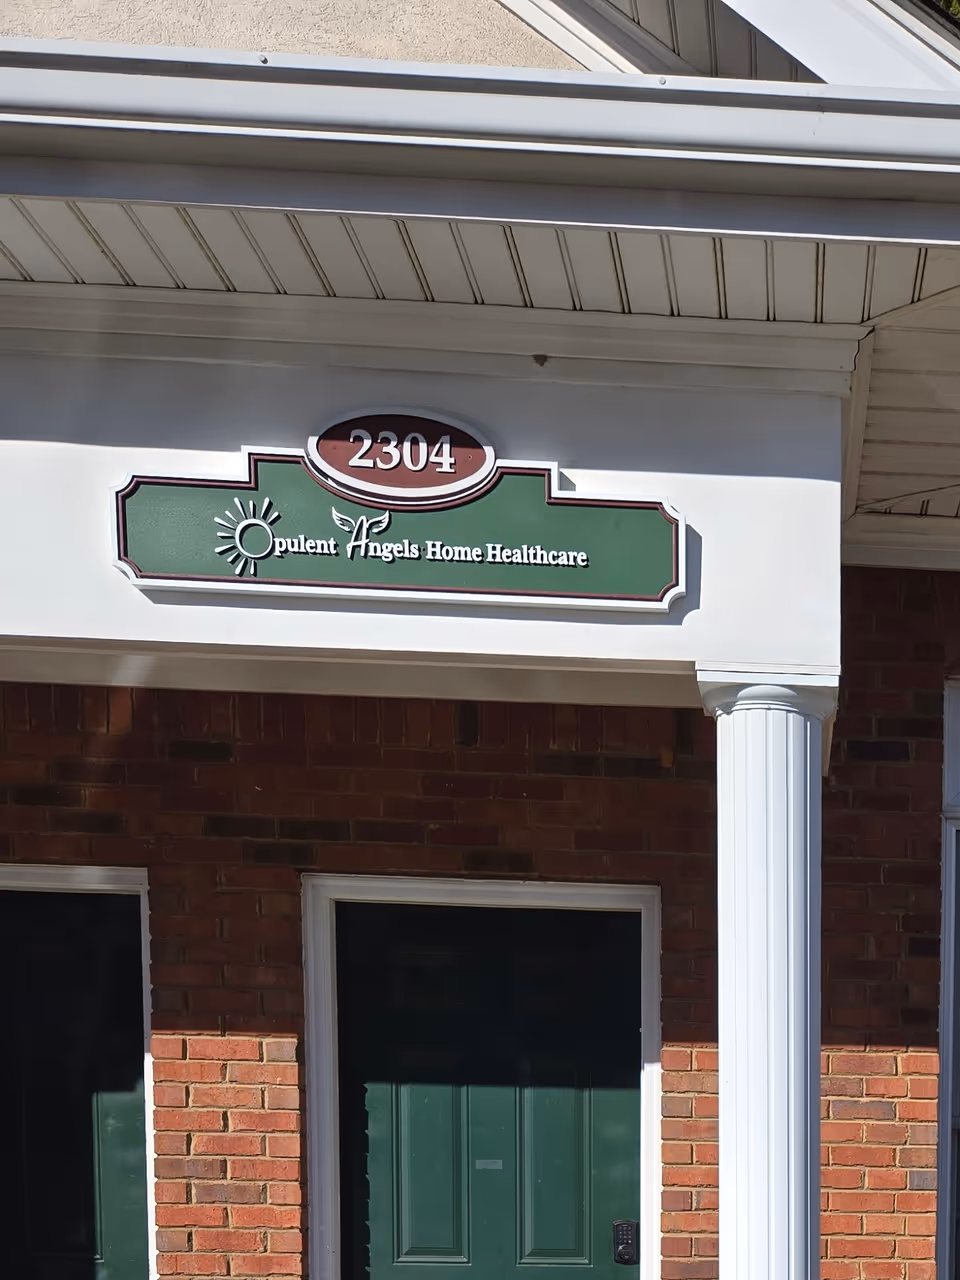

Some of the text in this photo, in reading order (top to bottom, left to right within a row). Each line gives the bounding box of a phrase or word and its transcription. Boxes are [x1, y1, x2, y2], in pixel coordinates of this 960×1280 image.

[349, 429, 455, 473] 2304
[346, 515, 420, 561] Angels
[425, 540, 483, 562] Home
[486, 543, 588, 566] Healthcare
